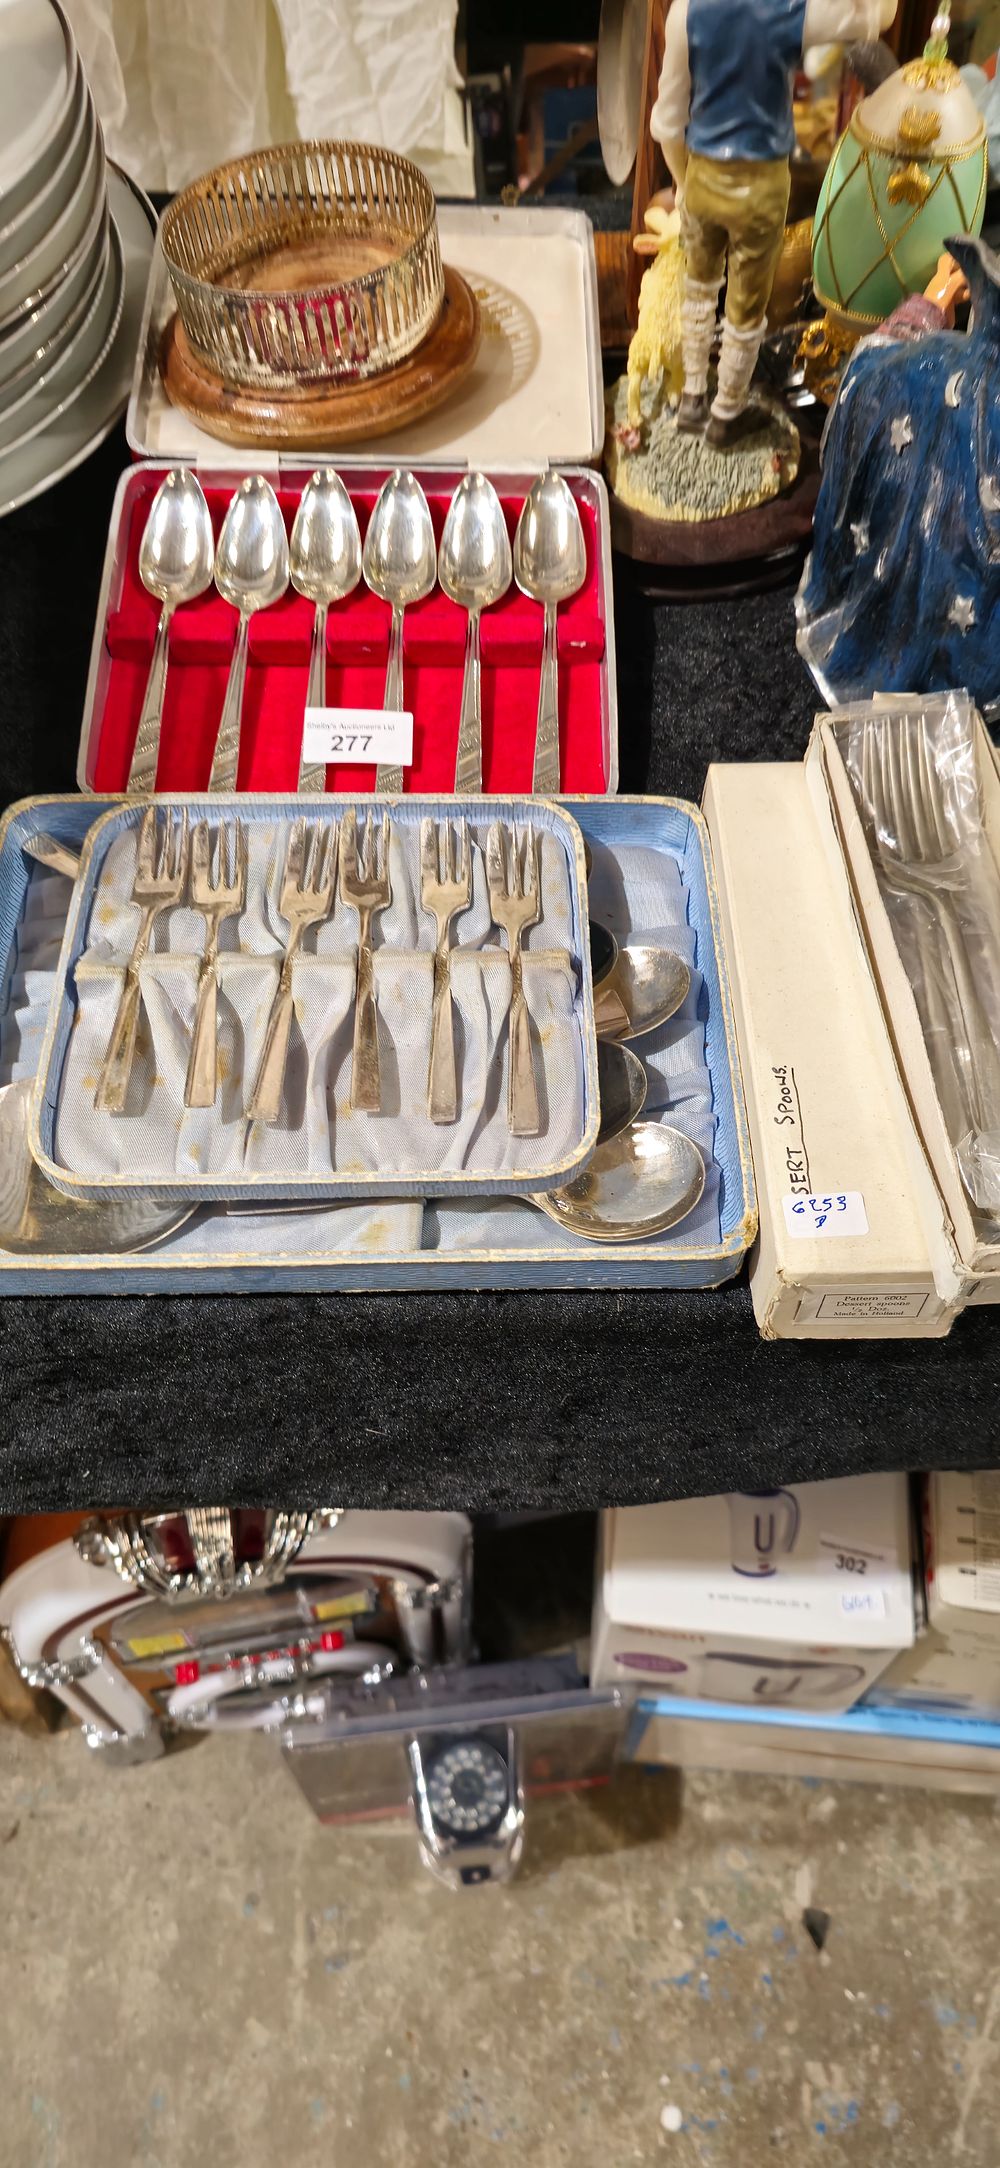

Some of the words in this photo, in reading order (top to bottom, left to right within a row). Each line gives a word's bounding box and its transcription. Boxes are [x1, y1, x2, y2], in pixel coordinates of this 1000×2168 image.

[339, 722, 382, 730] Auctioneers
[330, 735, 373, 752] 277
[791, 1195, 847, 1214] 6253
[835, 1553, 867, 1575] 302
